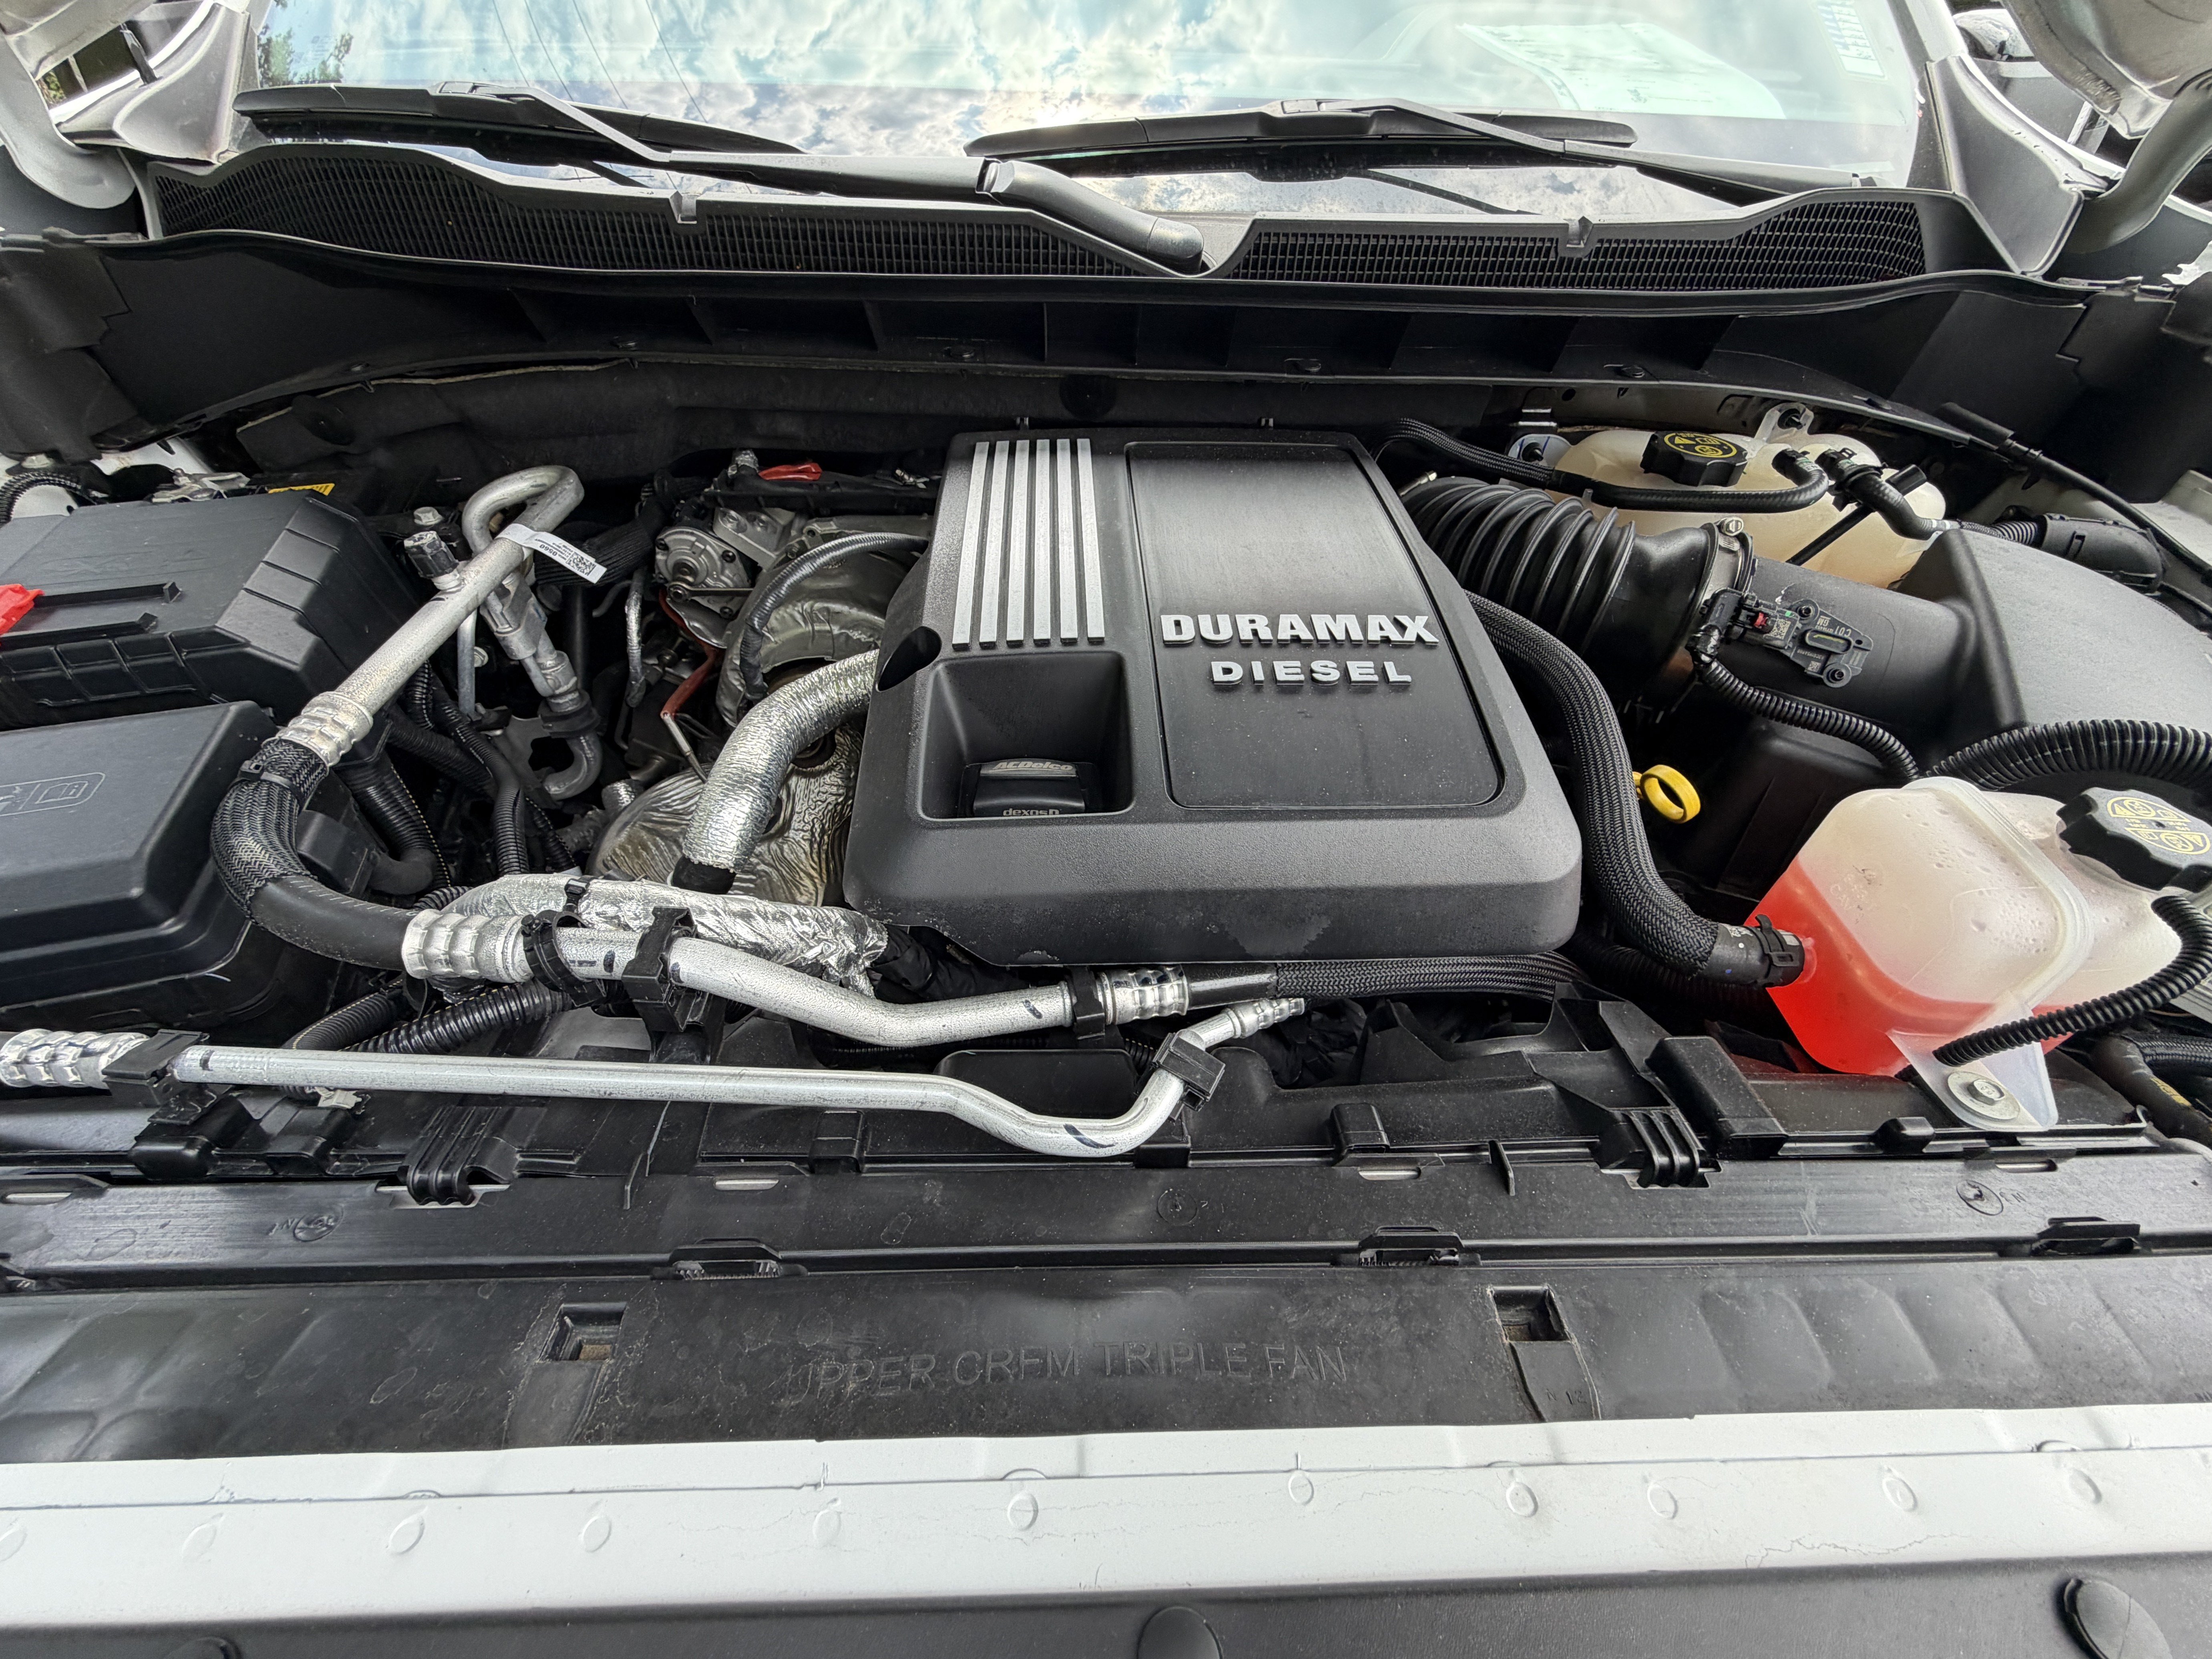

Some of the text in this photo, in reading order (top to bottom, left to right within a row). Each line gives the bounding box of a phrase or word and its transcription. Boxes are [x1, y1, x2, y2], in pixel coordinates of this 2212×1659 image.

[539, 544, 558, 556] 0560
[1817, 616, 1831, 626] GM
[1161, 614, 1439, 646] DURAMAX
[1210, 660, 1412, 685] DIESEL
[992, 761, 1073, 770] ACDelco
[1002, 808, 1060, 816] dexosD
[787, 1352, 936, 1405] UPPER
[1093, 1341, 1251, 1377] TRIPLE
[1263, 1343, 1347, 1381] FAN
